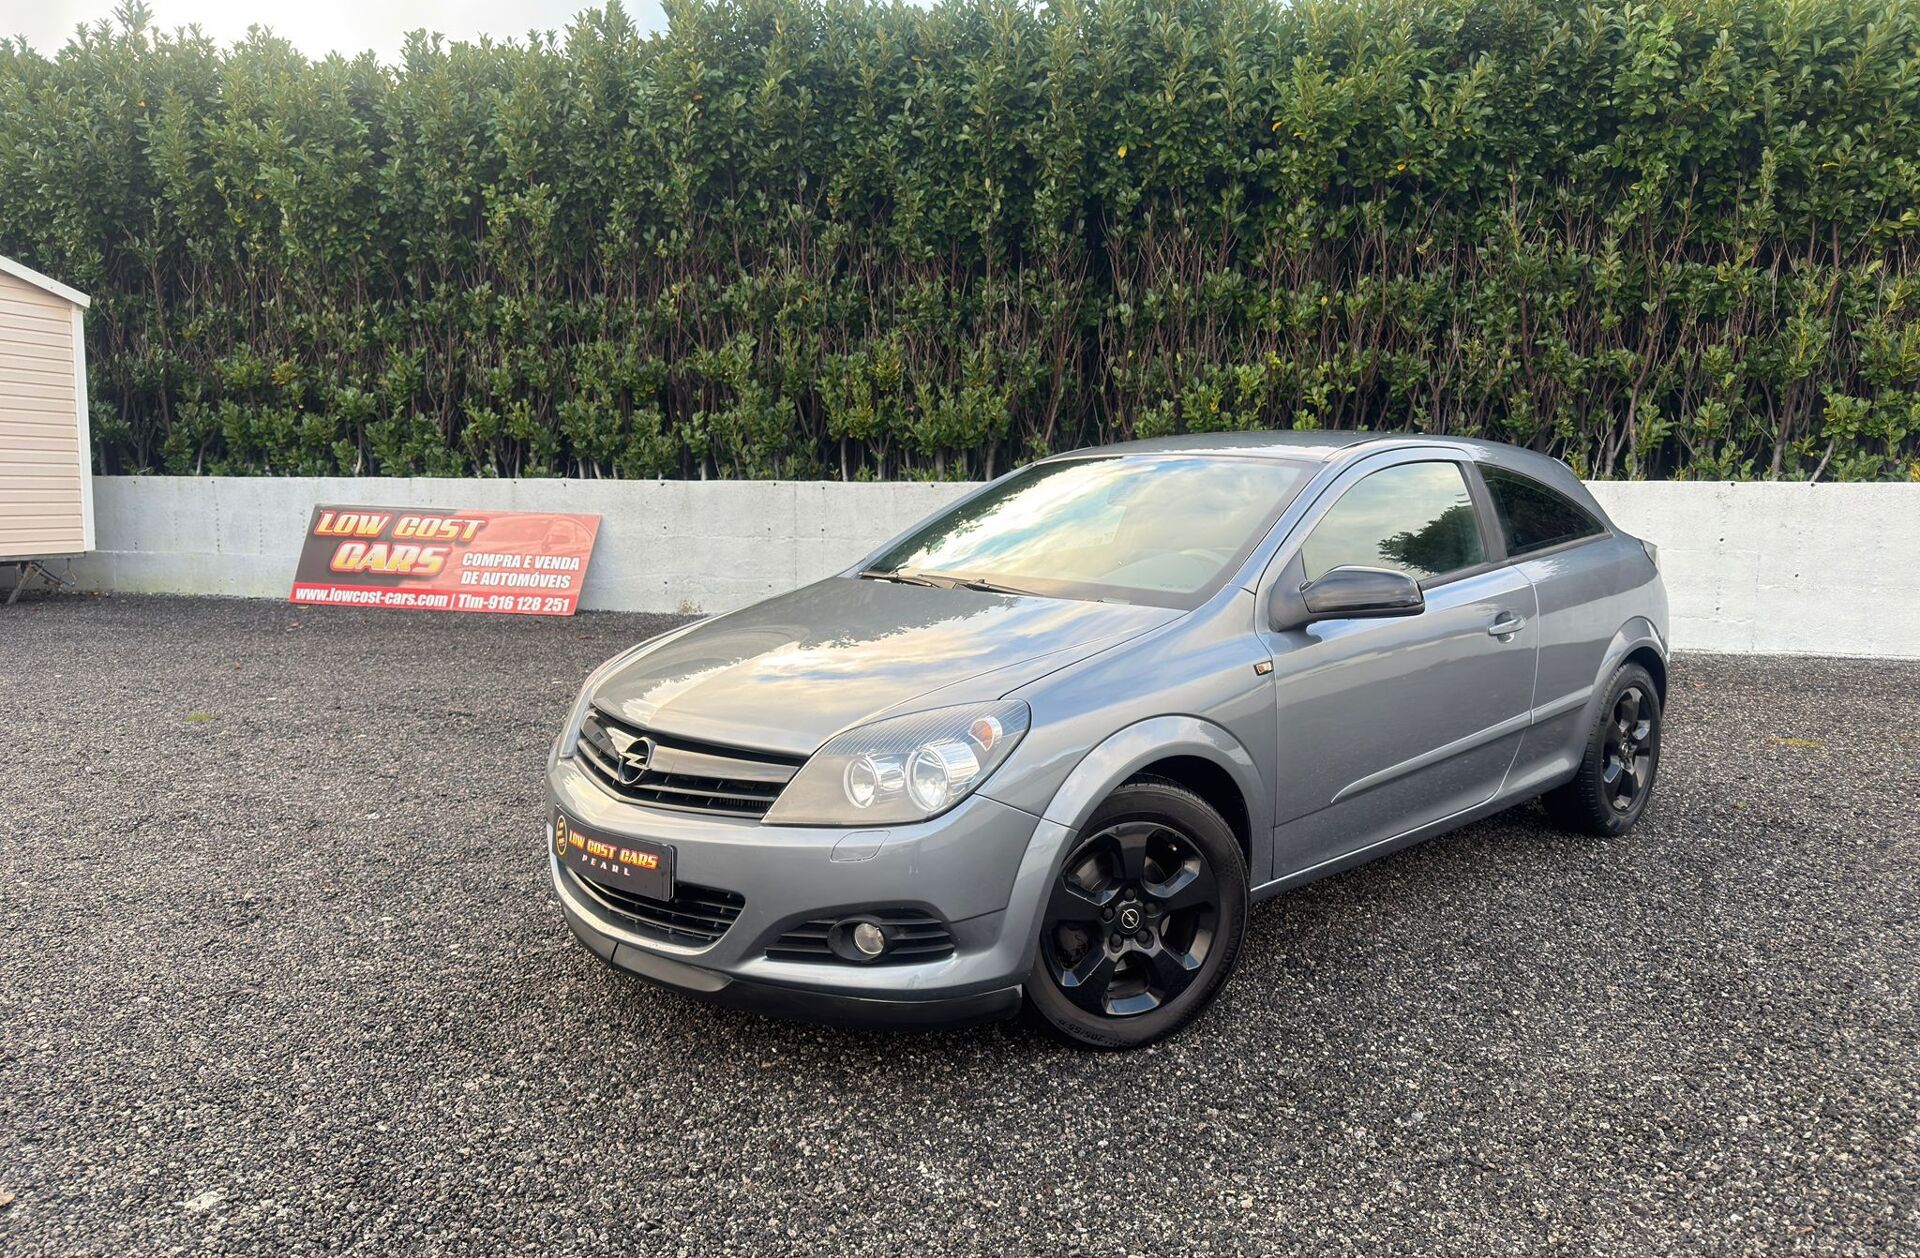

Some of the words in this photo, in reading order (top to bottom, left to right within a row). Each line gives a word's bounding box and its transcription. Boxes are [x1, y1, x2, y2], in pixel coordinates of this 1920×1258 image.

[314, 511, 390, 537] LOW
[393, 515, 486, 541] COST
[332, 542, 450, 573] CARS
[462, 552, 521, 569] COMPRA
[522, 555, 532, 568] E
[534, 555, 580, 571] VENDA
[461, 571, 480, 585] DE
[481, 572, 572, 588] AUTOMÓVEIS
[296, 587, 447, 608] www.lowcost-cars.com
[458, 593, 514, 610] Tlm-916
[516, 597, 541, 610] 128
[543, 598, 569, 612] 251
[568, 829, 585, 849] LOW
[587, 839, 617, 859] COST
[619, 848, 659, 870] CARS
[582, 854, 631, 876] PEARL
